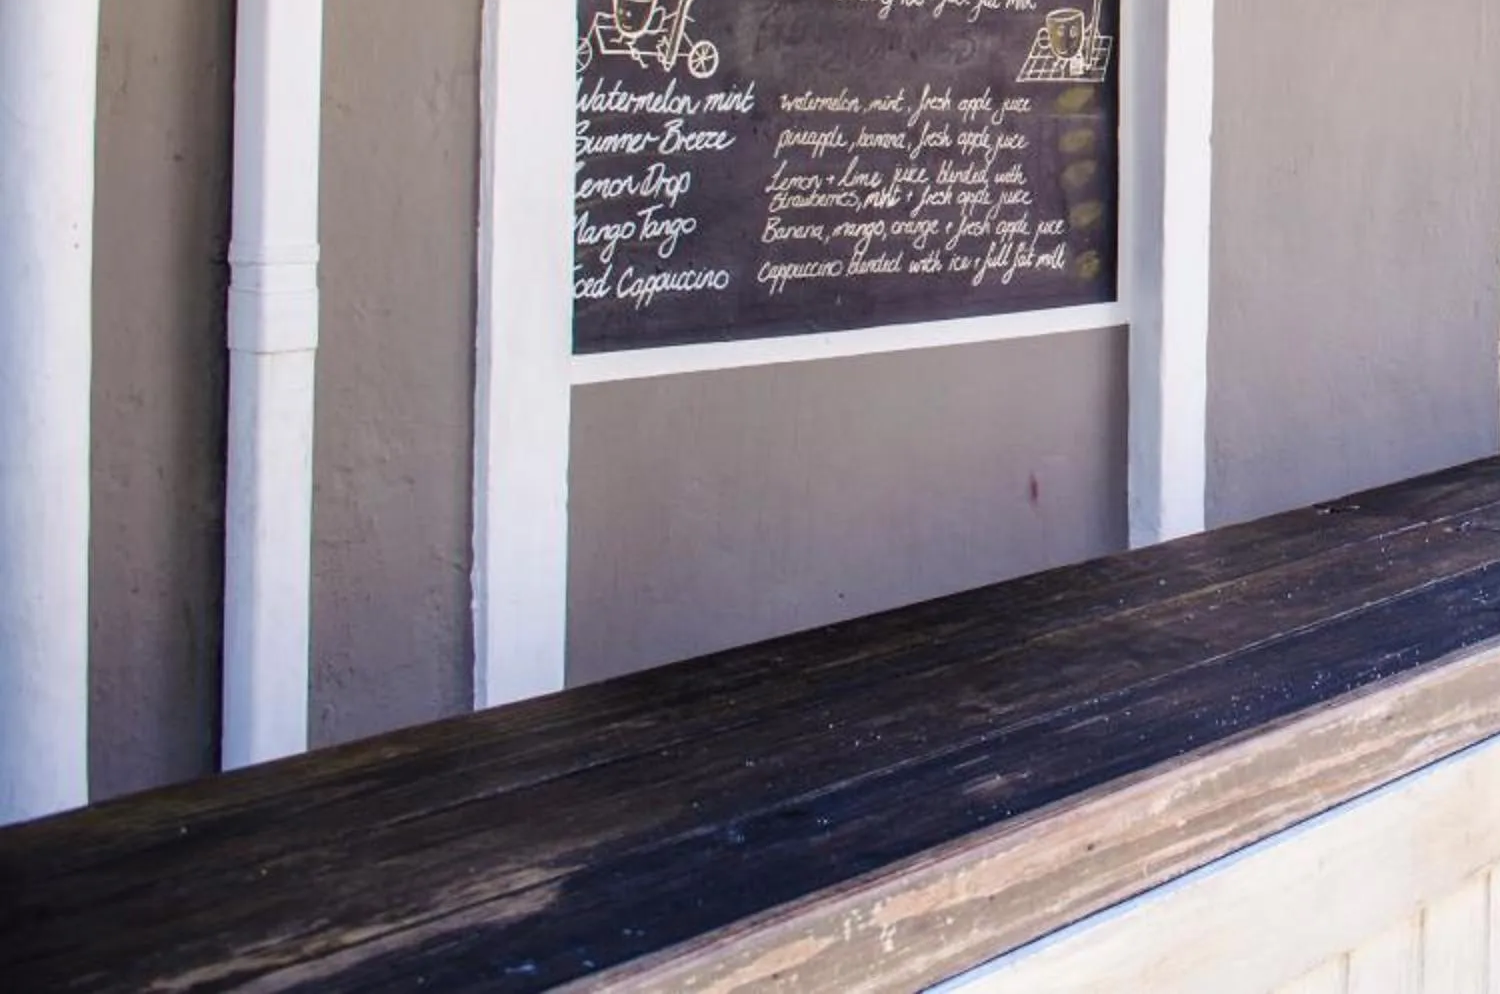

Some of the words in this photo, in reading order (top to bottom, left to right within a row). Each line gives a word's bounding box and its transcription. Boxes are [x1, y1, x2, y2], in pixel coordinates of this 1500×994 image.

[702, 81, 756, 114] mint
[576, 119, 660, 157] Summer
[658, 118, 737, 155] Breeze
[640, 162, 691, 208] Drop
[636, 204, 697, 259] Tango
